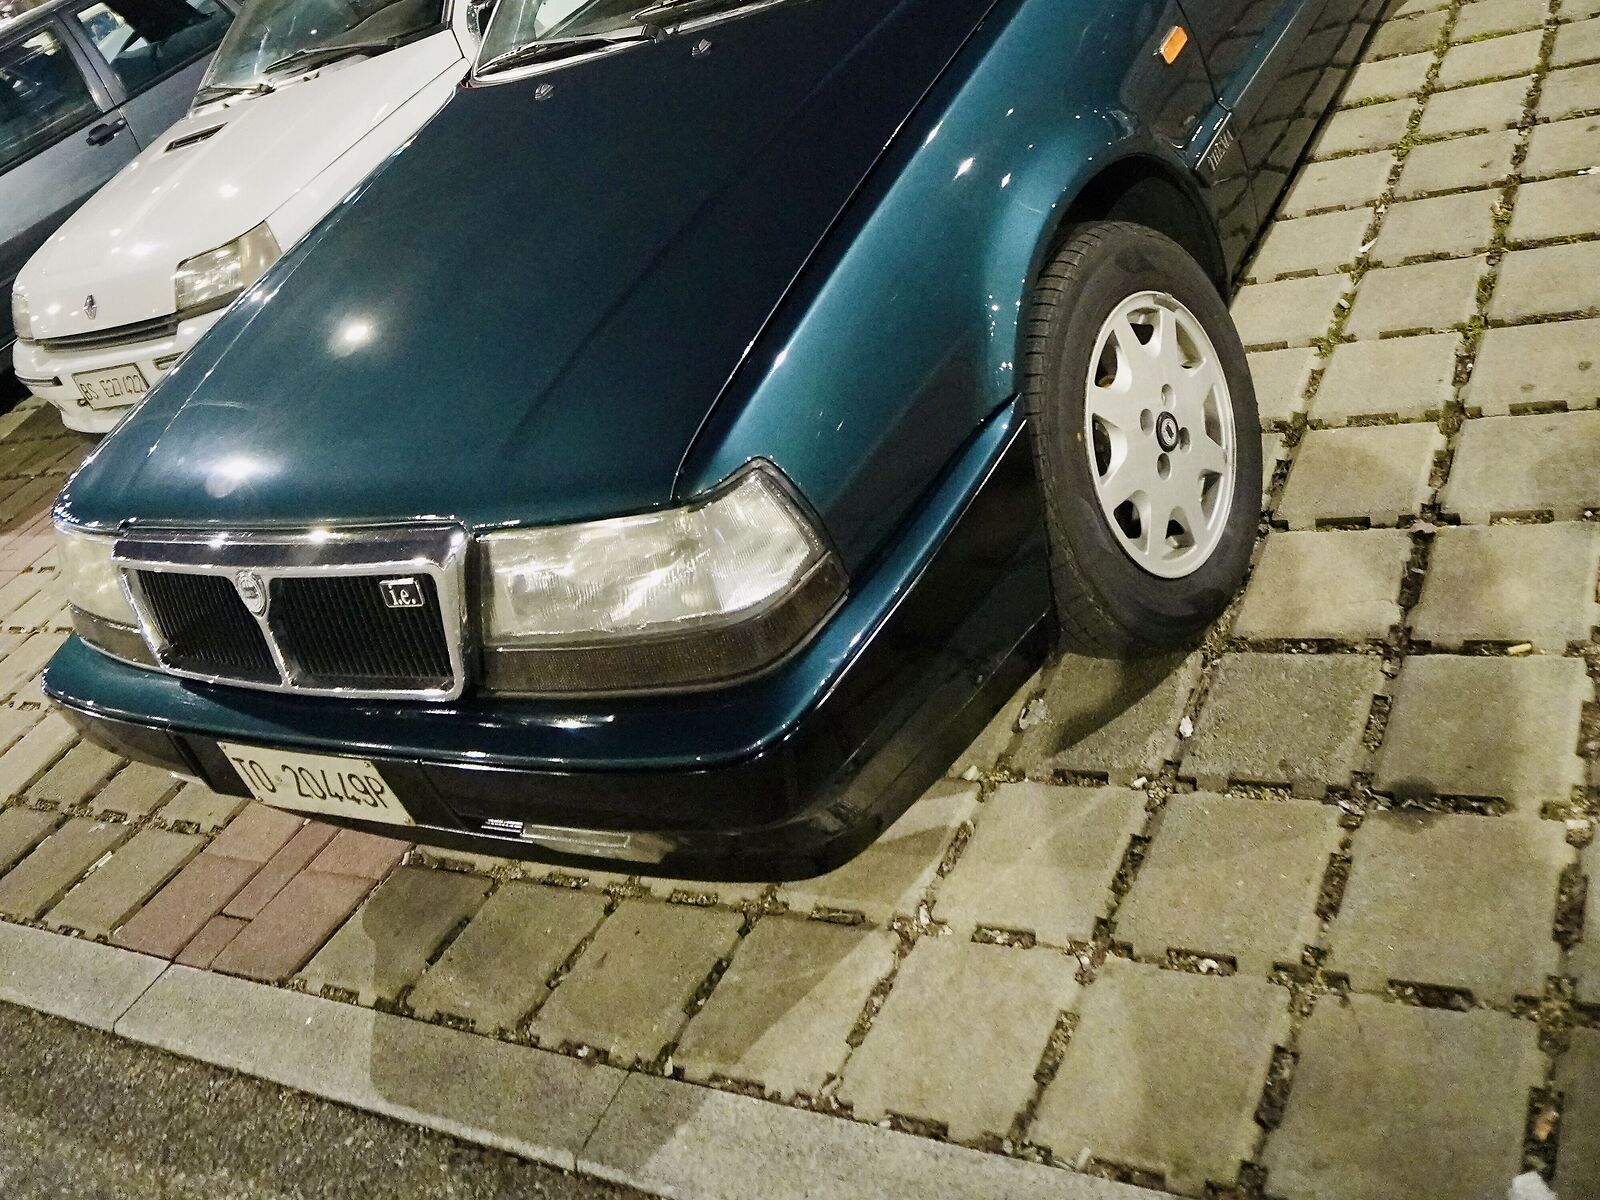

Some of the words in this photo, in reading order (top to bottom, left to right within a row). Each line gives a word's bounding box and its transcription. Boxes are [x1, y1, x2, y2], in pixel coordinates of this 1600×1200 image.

[79, 383, 99, 401] BS
[231, 756, 277, 793] TO
[281, 764, 388, 809] 20449P
